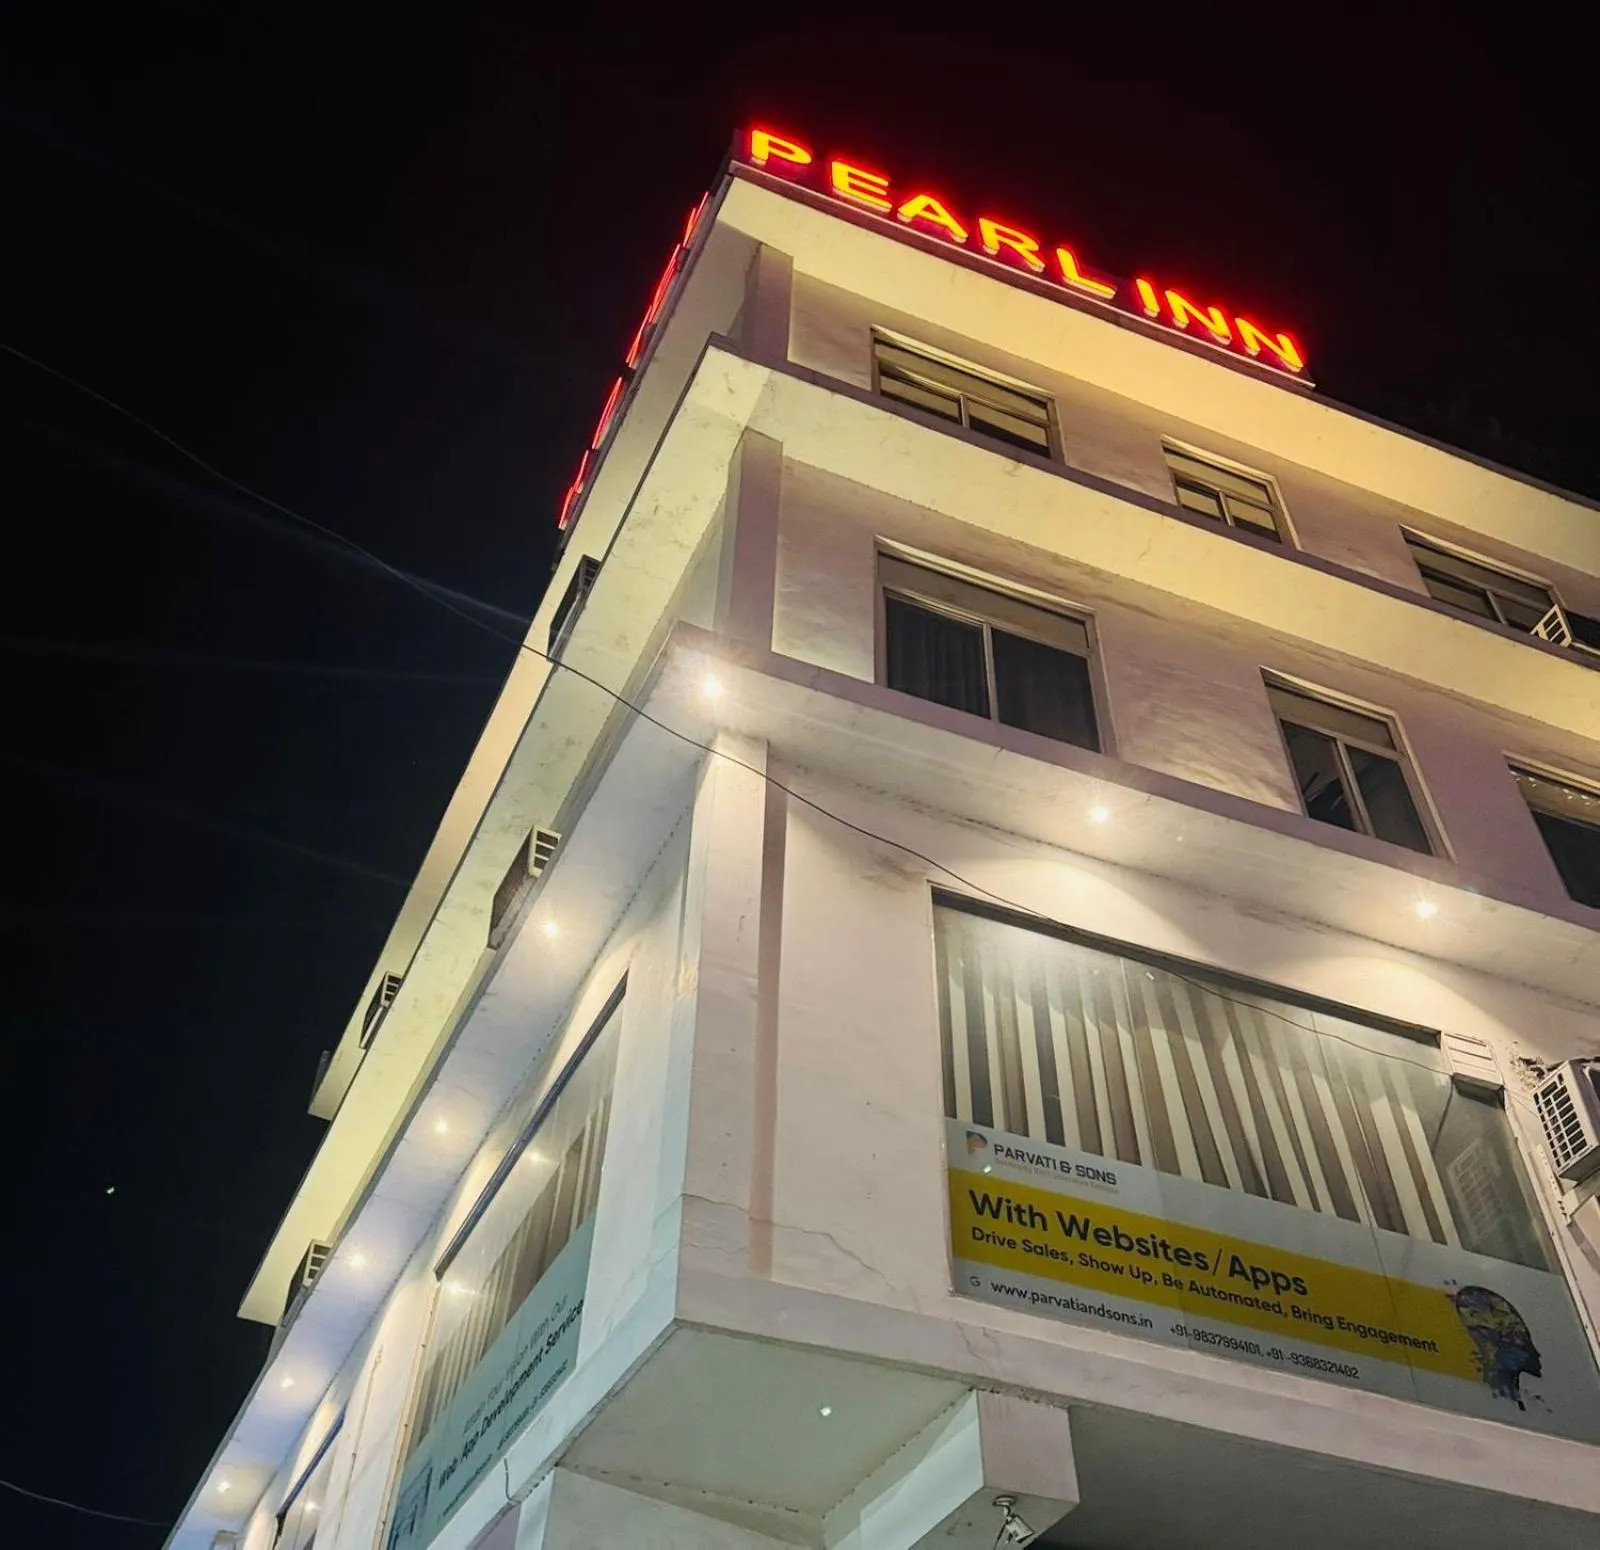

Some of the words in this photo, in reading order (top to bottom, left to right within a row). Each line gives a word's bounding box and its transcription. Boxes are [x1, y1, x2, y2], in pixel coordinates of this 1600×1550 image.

[751, 130, 1116, 299] PEARL
[1136, 278, 1304, 372] INN
[993, 1143, 1057, 1170] PARVATI
[1060, 1160, 1072, 1174] &
[1075, 1164, 1118, 1186] SONS
[969, 1189, 1048, 1231] With
[972, 1226, 1017, 1250] Drive
[1022, 1238, 1074, 1266] Sales,
[1078, 1252, 1125, 1275] Show
[1129, 1264, 1158, 1286] Up,
[1162, 1272, 1184, 1290] Be
[1188, 1280, 1288, 1319] Automated,
[1292, 1304, 1334, 1330] Bring
[1338, 1315, 1439, 1354] Engagement
[991, 1281, 1154, 1329] www.parvatiandsons.in
[480, 1347, 544, 1438] Development
